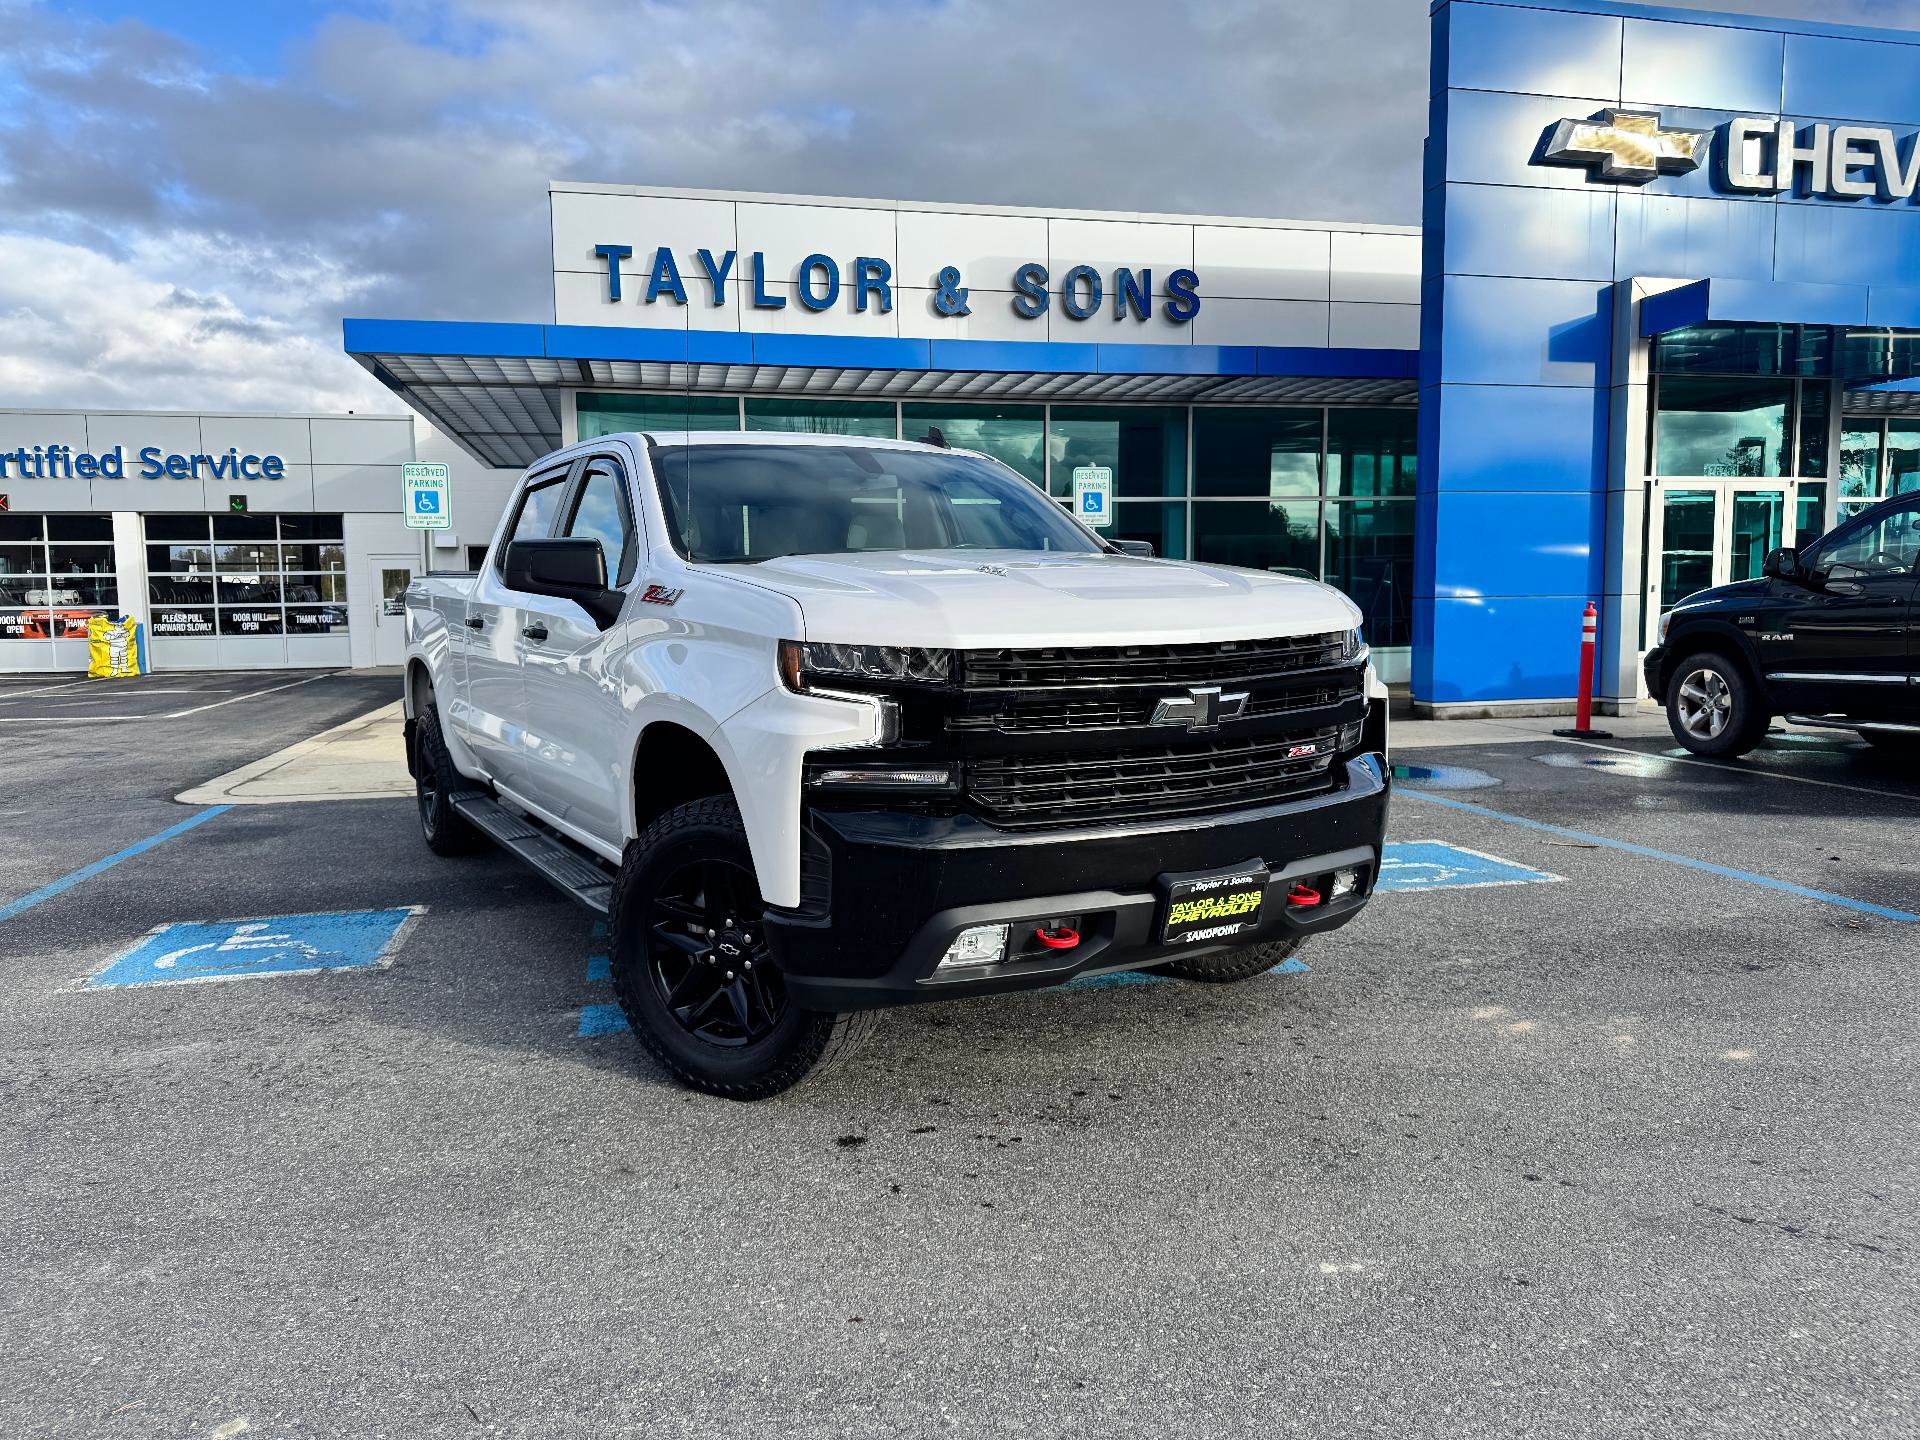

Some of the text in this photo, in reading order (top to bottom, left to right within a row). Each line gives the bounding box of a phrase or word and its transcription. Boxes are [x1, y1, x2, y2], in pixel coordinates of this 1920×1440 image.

[594, 244, 1201, 322] TAYLOR & SONS
[139, 446, 284, 480] Service
[405, 467, 445, 476] RESERVED
[1076, 472, 1108, 480] RESERVED
[408, 479, 444, 488] PARKING
[1078, 482, 1107, 490] PARKING
[17, 615, 34, 625] WILL
[161, 613, 204, 623] PLEASE PULL
[232, 613, 268, 622] DOOR WILL
[295, 614, 333, 624] THANK YOU!
[64, 618, 87, 628] THANK
[153, 622, 213, 632] FORWARD SLOWLY
[241, 621, 259, 631] OPEN
[6, 625, 25, 634] OPEN
[1761, 633, 1794, 641] RAM
[1196, 881, 1223, 891] Taylor
[1171, 890, 1262, 914] TAYLOR & SONS
[1168, 900, 1262, 925] CHEVROLET
[1186, 923, 1241, 943] SANDPOINT
